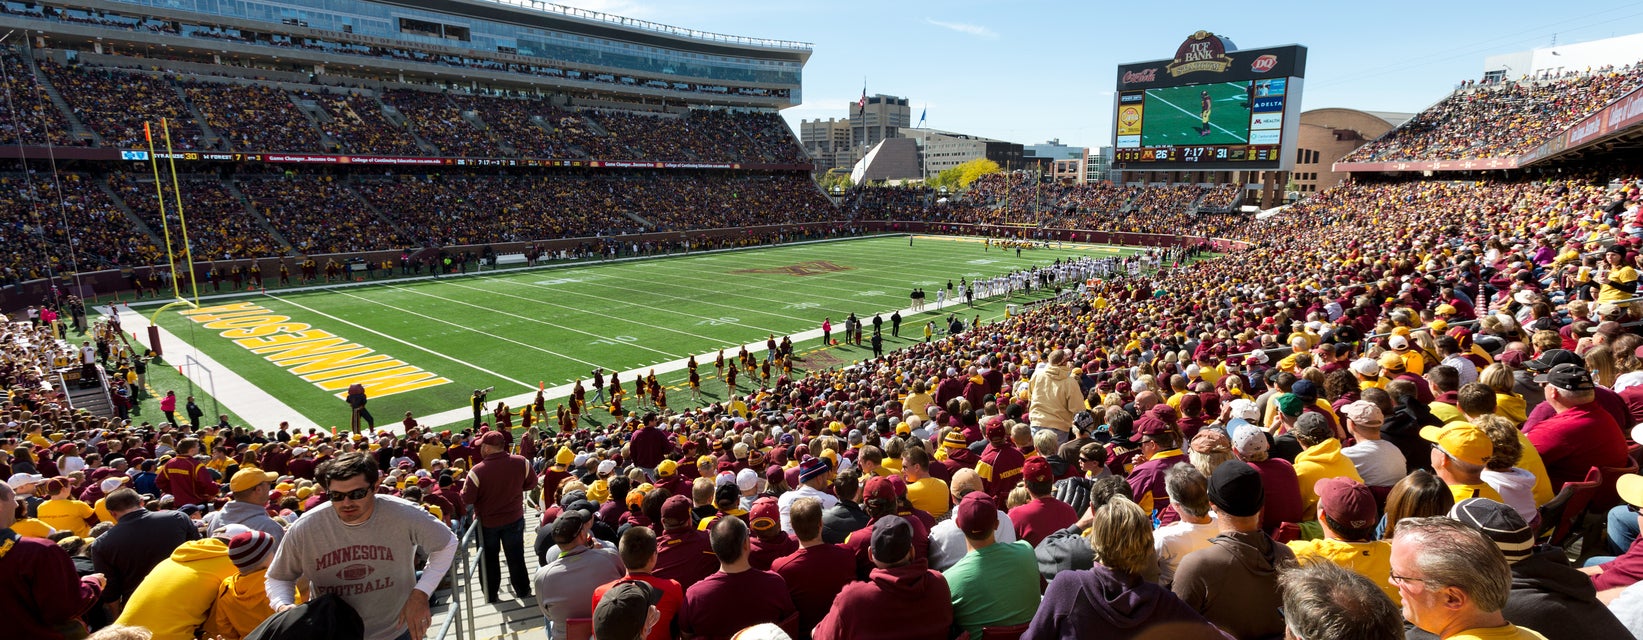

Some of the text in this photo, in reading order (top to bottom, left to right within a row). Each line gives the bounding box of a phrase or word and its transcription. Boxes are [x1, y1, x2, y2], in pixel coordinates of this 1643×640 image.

[310, 29, 374, 43] UNIVERSITY
[396, 40, 449, 52] MINNESOTA
[1190, 41, 1211, 53] TCF
[1185, 49, 1213, 62] BANK
[535, 57, 567, 67] STADIUM
[1176, 61, 1221, 74] STADIUM
[1256, 58, 1274, 69] DQ
[1124, 152, 1130, 160] 3
[1133, 152, 1139, 160] 3
[1155, 150, 1168, 159] 26
[1183, 147, 1204, 157] 7:17
[1216, 148, 1228, 158] 31
[177, 301, 454, 401] MINNESOTA
[315, 544, 394, 571] MINNESOTA
[317, 576, 394, 597] FOOTBALL
